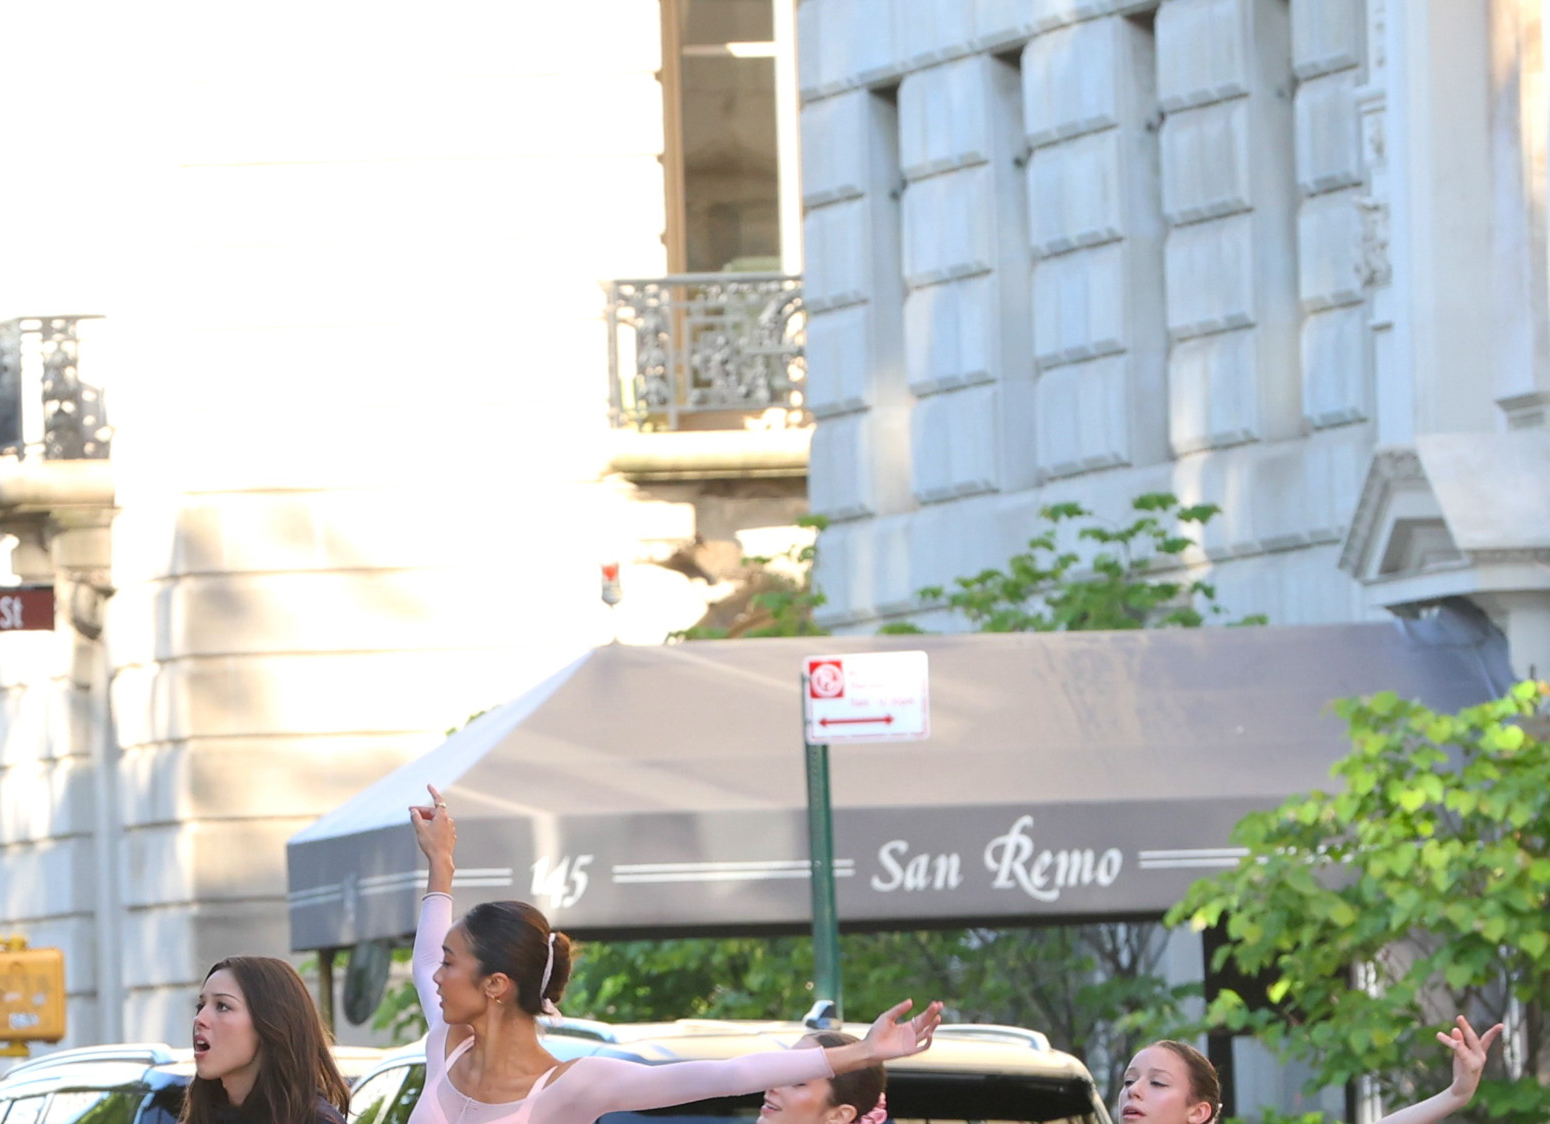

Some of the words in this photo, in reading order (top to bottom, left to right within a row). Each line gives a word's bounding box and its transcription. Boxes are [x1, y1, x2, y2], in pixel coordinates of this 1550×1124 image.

[530, 854, 594, 909] 145
[870, 839, 963, 892] San
[983, 815, 1123, 902] Remo
